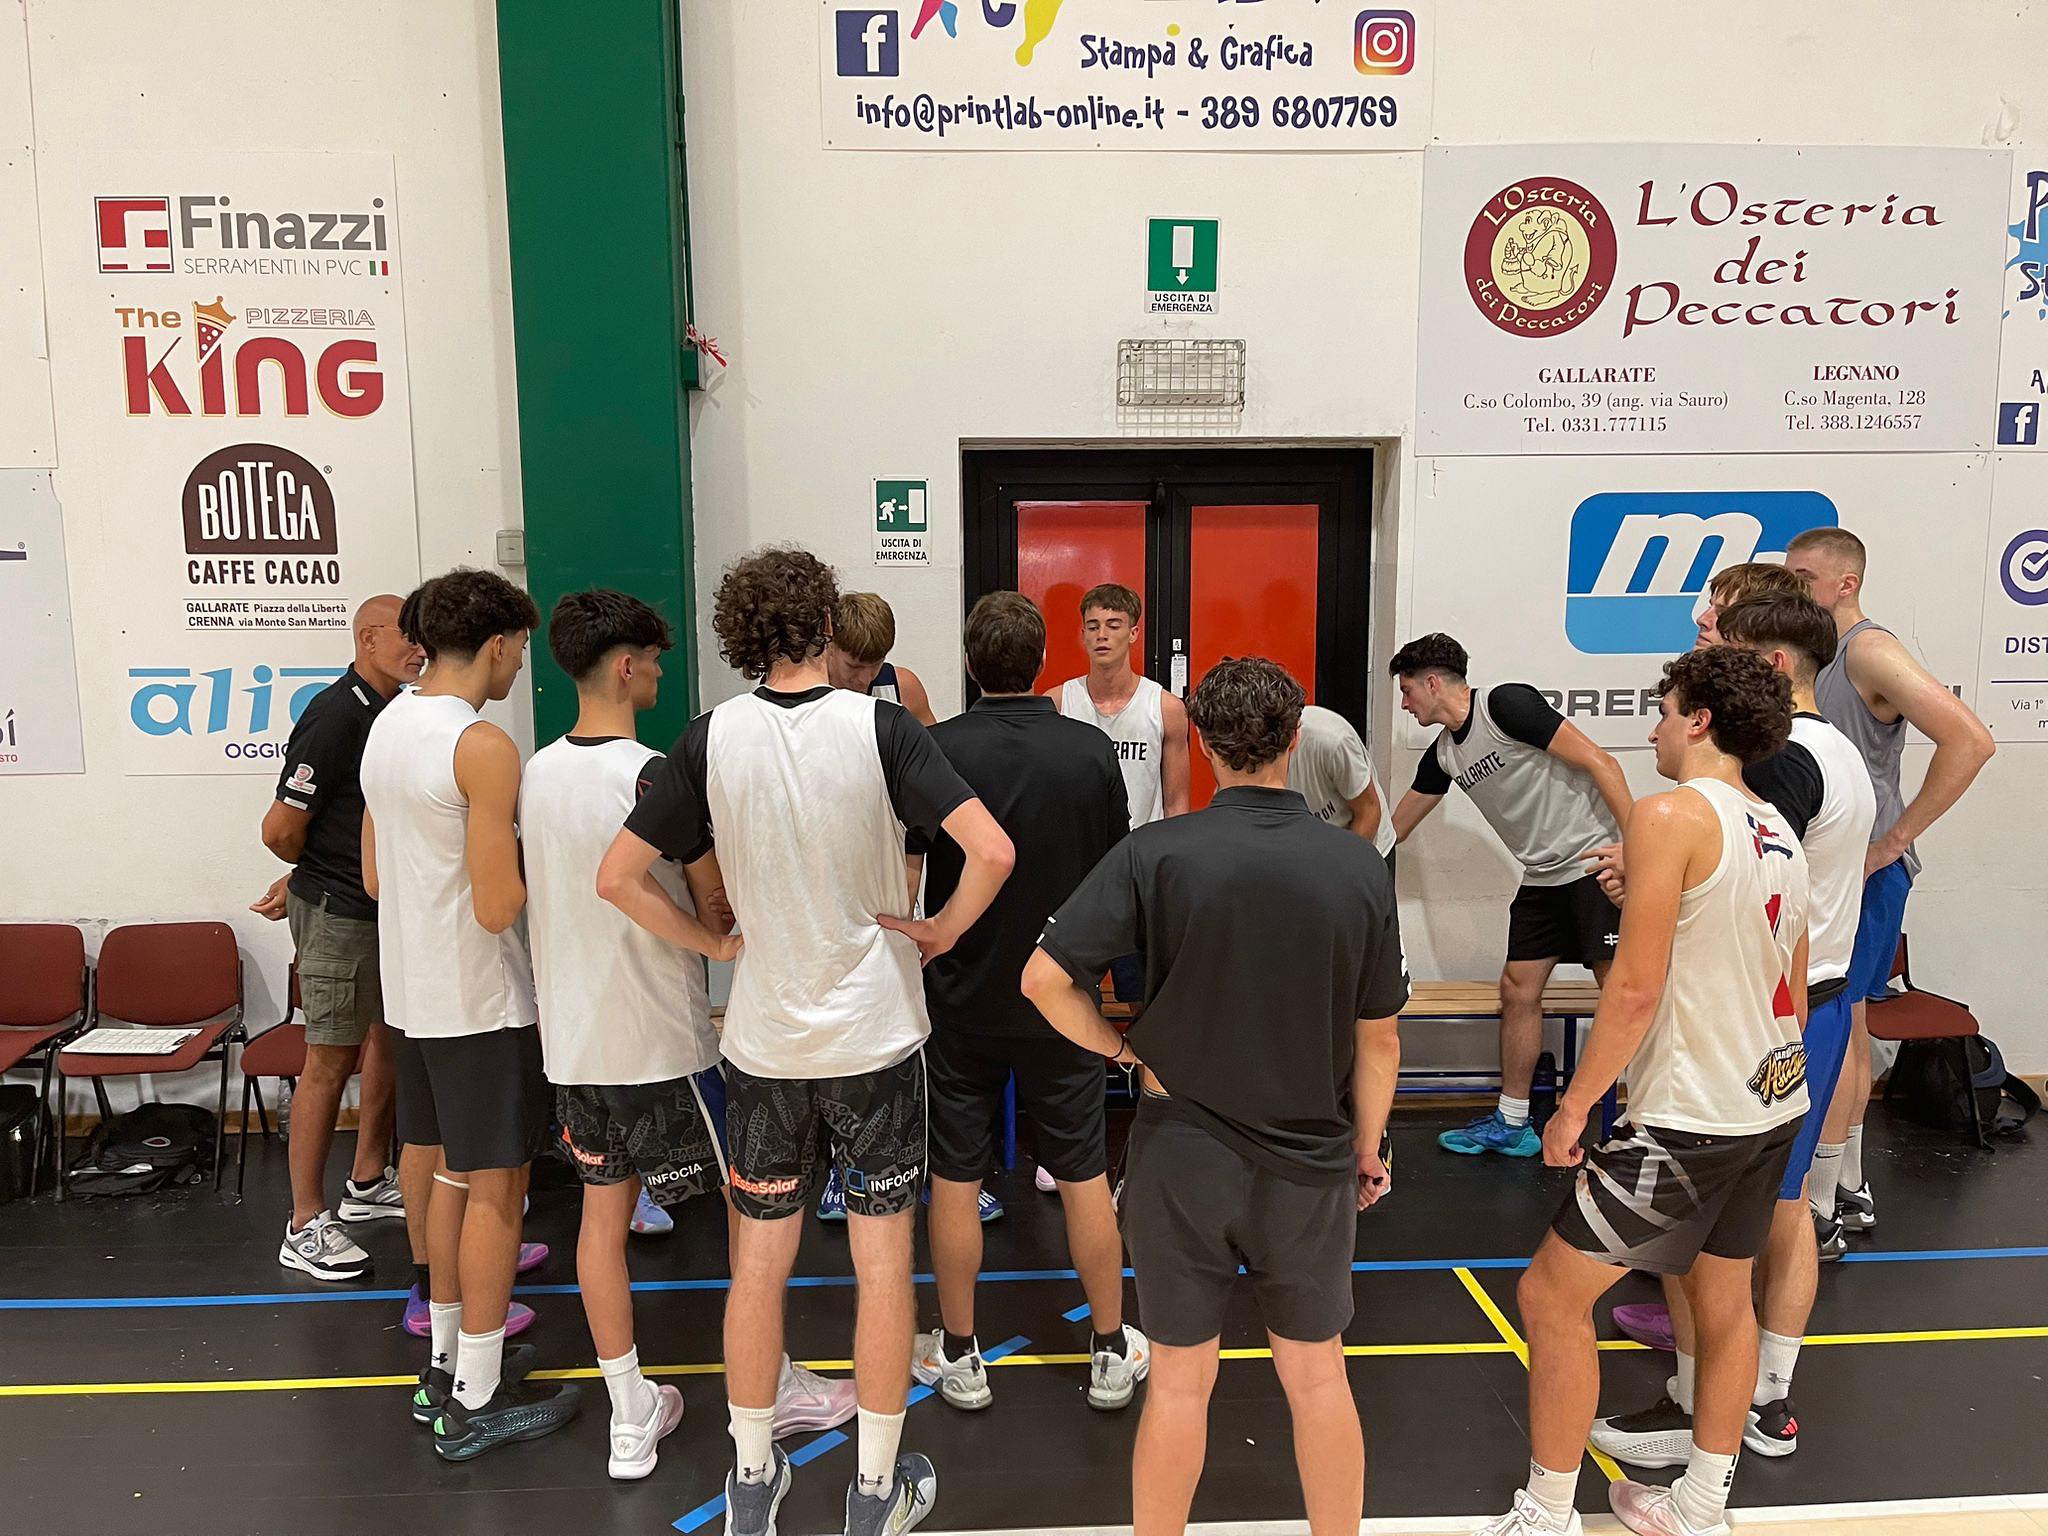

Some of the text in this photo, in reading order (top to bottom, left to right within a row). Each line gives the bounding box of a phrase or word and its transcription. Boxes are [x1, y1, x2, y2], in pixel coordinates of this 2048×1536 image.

[1081, 35, 1313, 78] Stampa & Grafica
[856, 94, 1165, 137] info@printlab-online.it
[1201, 96, 1260, 129] 389
[1272, 96, 1398, 129] 6807769
[1484, 186, 1599, 228] L'Osteria
[1636, 180, 1945, 227] L'Osteria
[180, 196, 388, 251] Finazzi
[184, 258, 361, 276] SERRAMENTI IN PVC
[1713, 235, 1809, 285] dei
[1154, 293, 1210, 303] USCITA DI
[1476, 278, 1603, 329] dei Peccatori
[245, 307, 376, 326] PIZZERIA
[1150, 303, 1213, 313] EMERGENZA
[1622, 280, 1961, 339] Peccatori
[115, 308, 182, 329] The
[1538, 367, 1656, 384] GALLARATE
[1813, 365, 1900, 381] LEGNANO
[1464, 391, 1728, 411] C.so Colombo, 39 (ang. via Sauro)
[1784, 391, 1926, 409] C.so Magenta, 128
[1524, 416, 1667, 433] Tel. 0331.777115
[1785, 414, 1922, 430] Tel. 388.1246557
[197, 461, 321, 541] BOTEGA
[881, 539, 922, 548] USCITA DI
[875, 550, 928, 562] EMERGENZA
[188, 560, 340, 585] CAFFE CACAO
[186, 602, 347, 613] GALLARATE Piazza della Libertà
[188, 616, 347, 627] CRENNA via Monte San Martino
[2012, 699, 2031, 710] Via
[0, 754, 18, 763] STO
[1113, 740, 1148, 760] RATE
[1455, 750, 1507, 790] ALLARATE
[647, 1162, 704, 1187] INFOCIA
[869, 1165, 920, 1192] INFOCIA
[734, 1176, 800, 1195] EsseSolar
